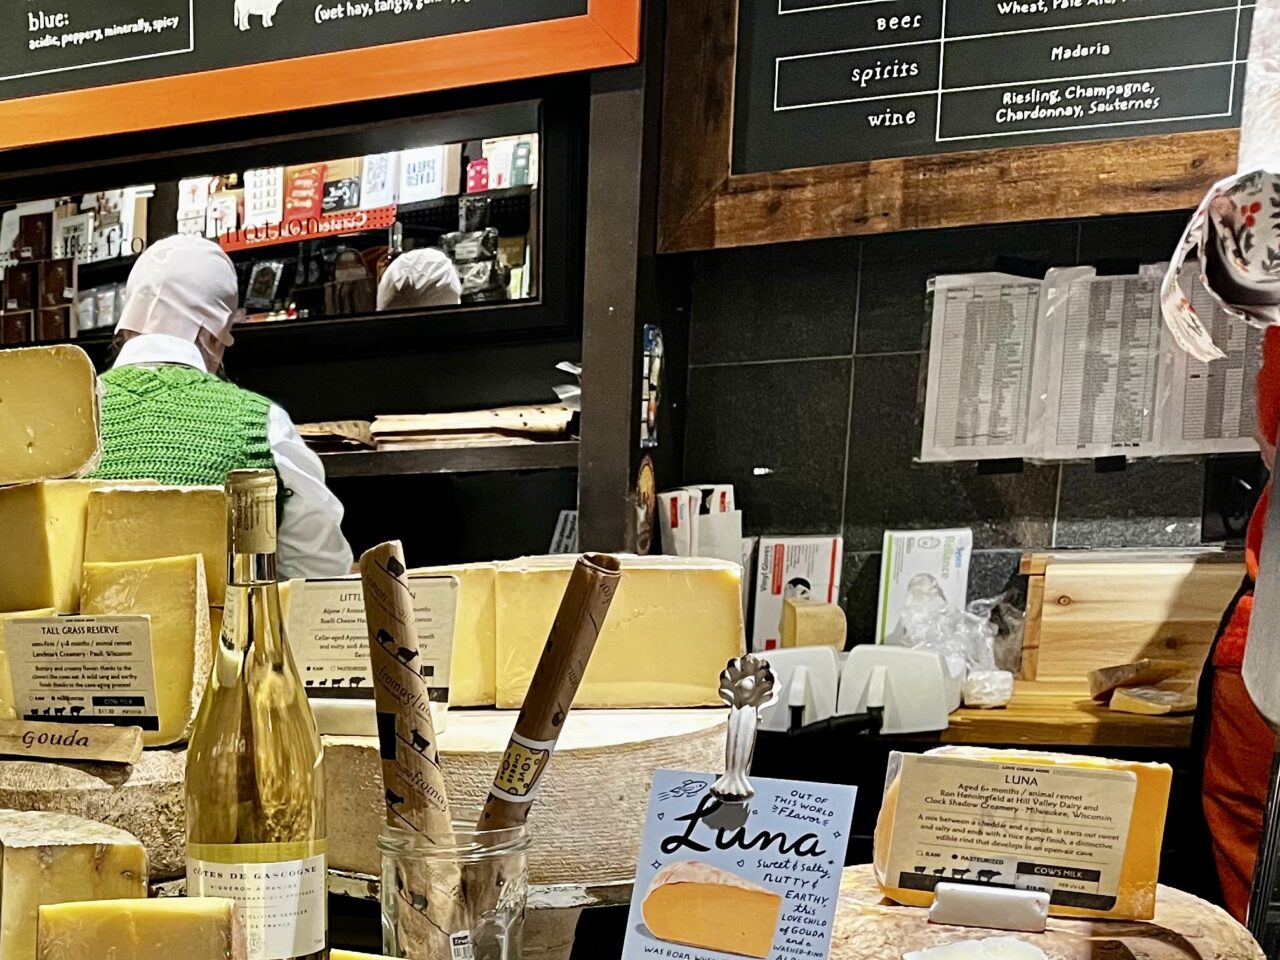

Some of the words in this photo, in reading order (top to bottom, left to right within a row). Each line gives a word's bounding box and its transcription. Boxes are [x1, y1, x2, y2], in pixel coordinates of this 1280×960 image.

[315, 4, 344, 23] (wet
[347, 2, 373, 17] hay,
[997, 1, 1049, 15] Wheat,
[28, 11, 69, 31] blue:
[152, 16, 179, 33] spicy
[876, 14, 921, 31] Beer
[1050, 43, 1110, 61] Maderia
[852, 60, 919, 87] spirits
[1002, 88, 1061, 105] Riesling,
[1065, 81, 1155, 100] Champagne,
[868, 109, 916, 127] wine
[995, 106, 1084, 124] Chardonnay,
[1088, 97, 1160, 114] Sauternes
[62, 626, 85, 634] GRASS
[87, 626, 119, 634] RESERVE
[22, 730, 89, 748] Gouda
[518, 758, 531, 782] LOVE
[1004, 774, 1038, 786] LUNA
[775, 795, 798, 808] THIS
[800, 801, 834, 817] WORLD
[790, 790, 811, 800] OUT
[814, 796, 828, 805] OF
[940, 789, 955, 798] Ron
[1007, 794, 1014, 802] at
[1016, 795, 1030, 804] Hill
[1033, 797, 1057, 808] Valley
[1059, 800, 1081, 812] Dairy
[1083, 803, 1098, 812] and
[924, 796, 946, 806] Clock
[948, 798, 978, 808] Shadow
[980, 802, 1018, 814] Creamery
[1026, 806, 1070, 818] Milwaukee,
[1072, 811, 1112, 822] Wisconsin
[660, 794, 827, 857] Luna
[253, 865, 317, 880] GASCOGNE
[757, 859, 791, 871] sweet
[801, 863, 831, 879] salty,
[1063, 870, 1083, 879] MILK
[785, 890, 830, 908] EARTHY,
[793, 903, 816, 916] this
[781, 914, 802, 924] LOVE
[803, 916, 827, 927] CHILD
[779, 927, 790, 936] of
[791, 927, 825, 939] GOUDA
[786, 938, 803, 946] and
[645, 947, 663, 955] WAS
